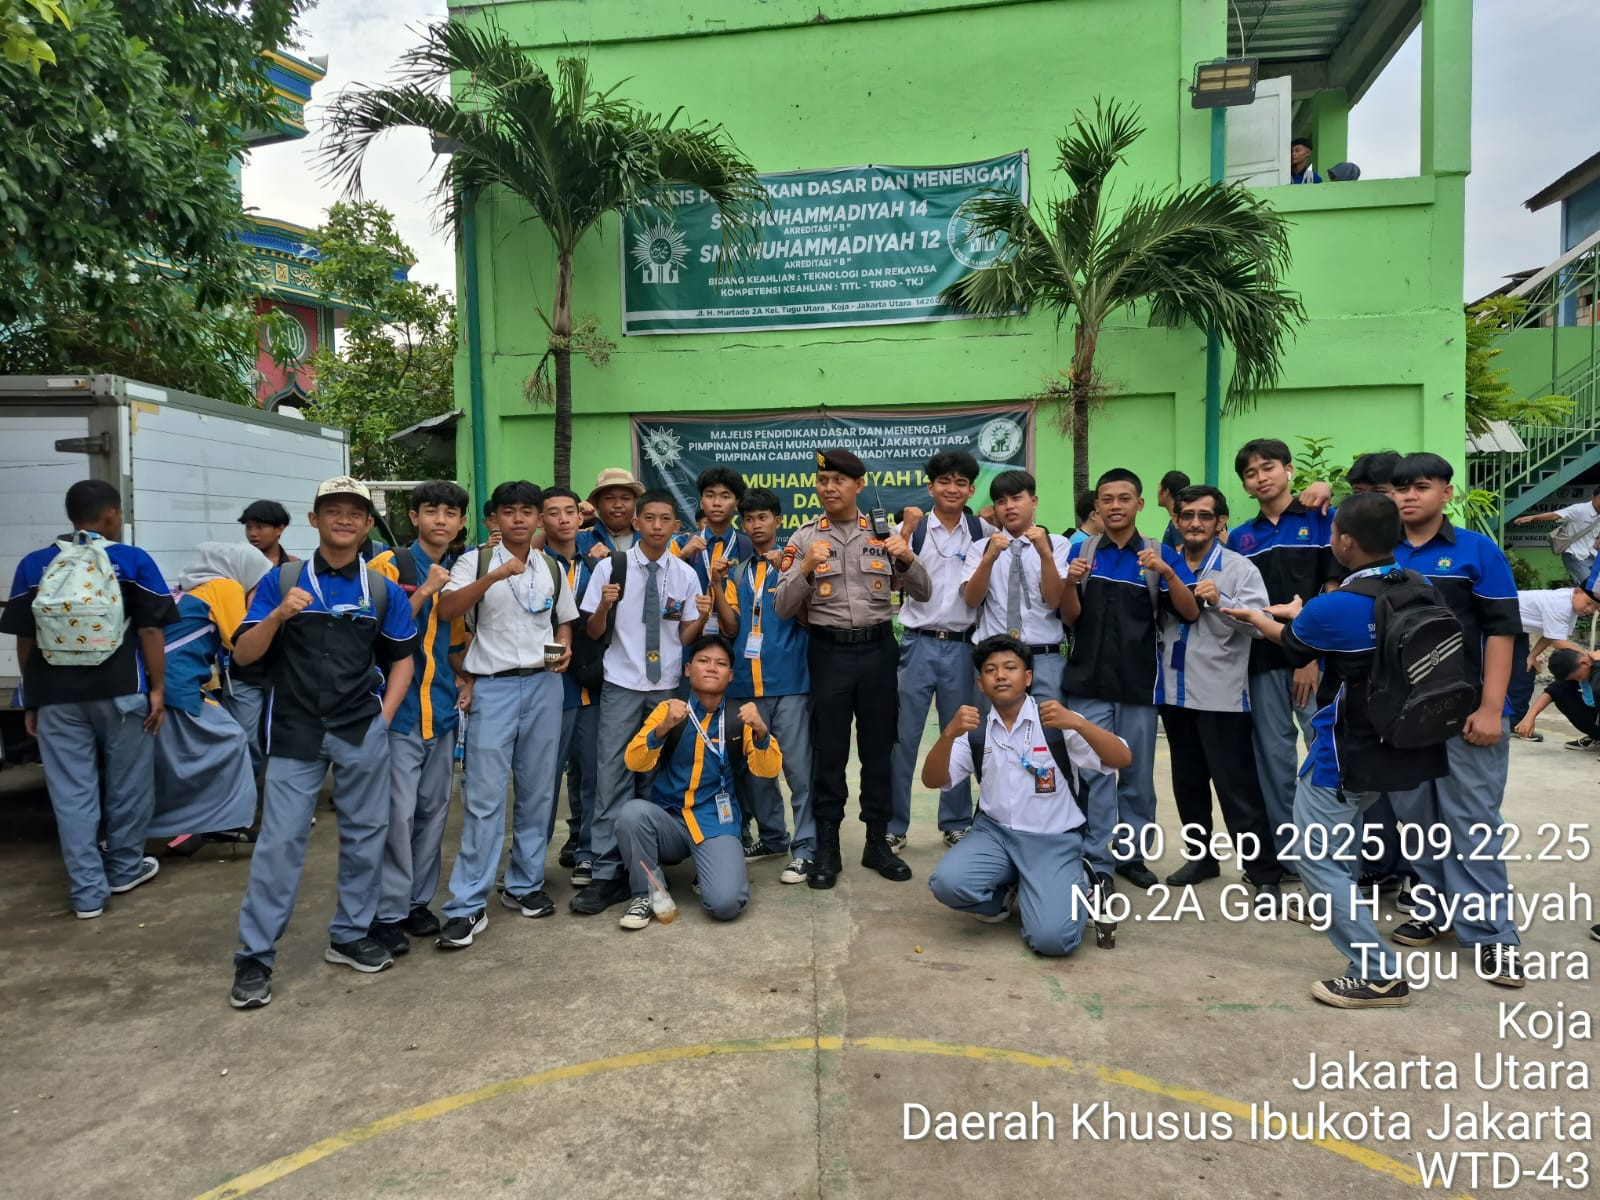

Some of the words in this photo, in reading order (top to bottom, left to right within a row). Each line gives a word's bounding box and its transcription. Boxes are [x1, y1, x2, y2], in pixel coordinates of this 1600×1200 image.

[807, 177, 867, 196] DASAR
[871, 174, 909, 192] DAN
[913, 164, 1016, 188] MENENGAH
[752, 201, 904, 227] MUHAMMADIYAH
[909, 199, 928, 217] 14
[783, 225, 831, 235] AKREDITASI
[920, 229, 941, 249] 12
[784, 257, 832, 269] AKREDITASI
[708, 276, 745, 286] BIDANG
[747, 274, 795, 284] KEAHLIAN
[803, 270, 859, 281] TEKNOLOGI
[861, 267, 883, 277] DAN
[884, 264, 937, 276] REKAYASA
[720, 286, 781, 297] KOMPETENSI
[783, 283, 833, 294] KEAHLIAN
[840, 281, 861, 291] TITL
[869, 280, 897, 289] TKRO
[905, 278, 924, 287] TKJ
[752, 306, 763, 315] 2A
[782, 305, 801, 315] Tugu
[803, 304, 825, 312] Utara
[831, 303, 849, 312] Koja
[856, 300, 887, 310] Jakarta
[889, 299, 912, 308] Utara
[710, 430, 753, 440] MAJELIS
[754, 428, 819, 439] PENDIDIKAN
[820, 426, 856, 437] DASAR
[859, 426, 883, 436] DAN
[884, 424, 947, 435] MENENGAH
[688, 441, 740, 451] PIMPINAN
[741, 440, 784, 450] DAERAH
[880, 436, 932, 447] JAKARTA
[934, 435, 970, 445] UTARA
[715, 452, 766, 462] PIMPINAN
[768, 451, 814, 461] CABANG
[793, 493, 824, 509] DA
